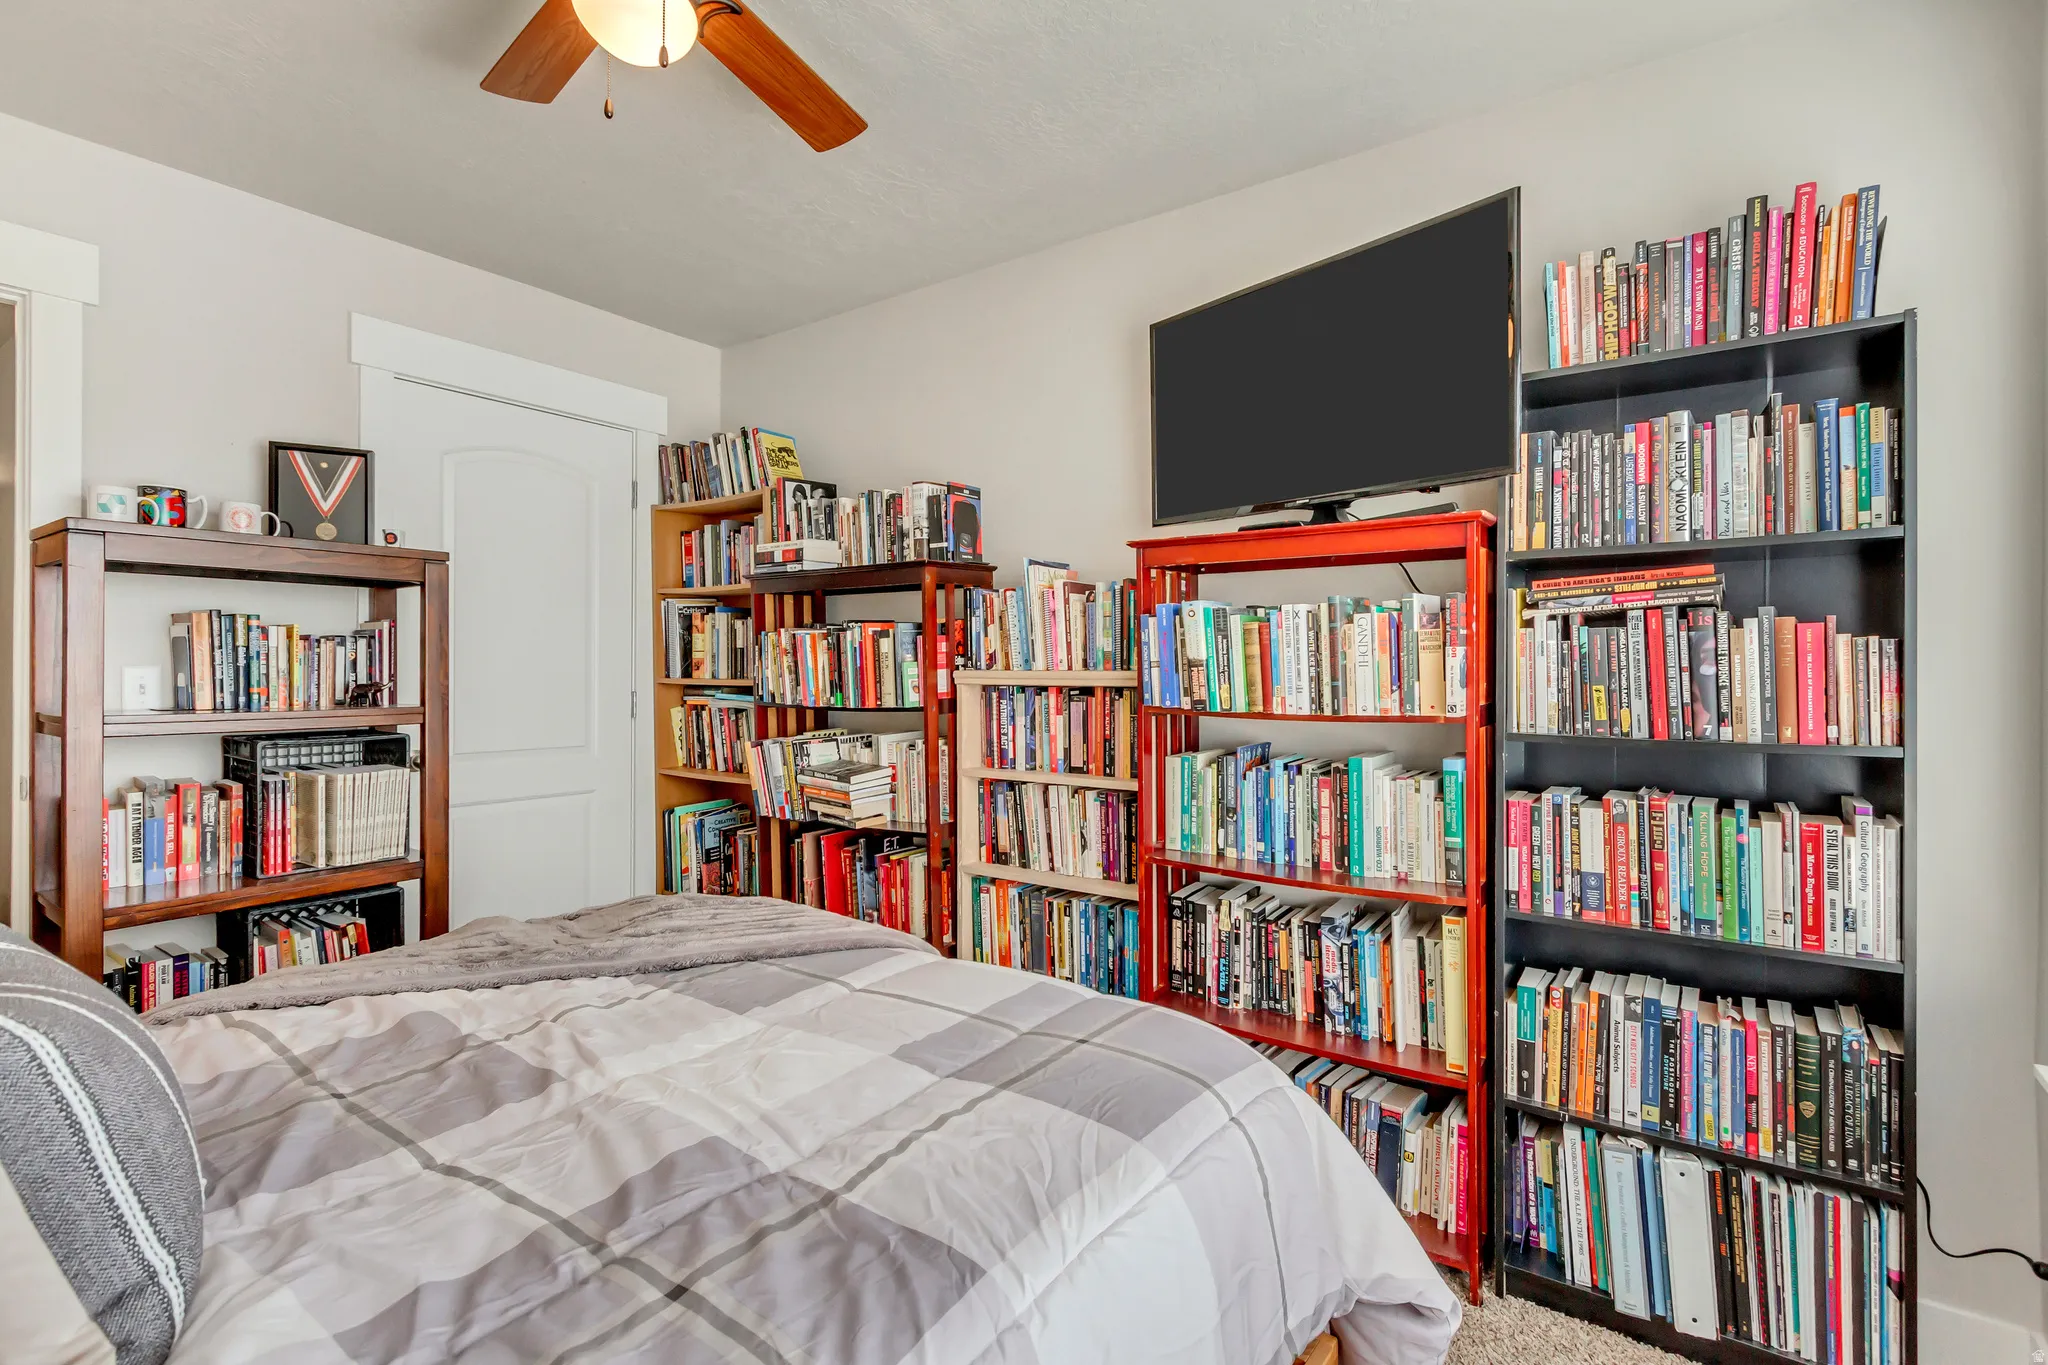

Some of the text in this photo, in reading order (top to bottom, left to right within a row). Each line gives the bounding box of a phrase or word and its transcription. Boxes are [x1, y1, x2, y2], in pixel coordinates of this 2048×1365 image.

[1865, 190, 1875, 228] REWEAVING
[1751, 232, 1761, 308] SOCIAL THEORY
[1695, 267, 1704, 330] HOW ANIMALS TALK
[1604, 300, 1618, 357] HIP HOP
[1594, 438, 1599, 447] WE
[1675, 441, 1686, 478] KLEIN
[1638, 443, 1646, 521] ACTIVIST'S HANDBOOK
[1719, 482, 1730, 537] Peace and War
[1553, 525, 1561, 548] NOAM
[1450, 598, 1458, 627] covert
[236, 617, 247, 667] Negotiating Globally
[1357, 617, 1369, 667] GANDHI
[1310, 667, 1315, 677] ME
[1665, 618, 1679, 707] ANIMAL OPPRESSION AND CAPITALISM
[1717, 613, 1729, 712] INADMISSIBLE EVIDENCE WILLIAMS
[1191, 667, 1199, 700] POWERFUL
[1000, 699, 1008, 734] PATRIOTS
[1750, 696, 1758, 725] ZIONISM
[131, 808, 142, 817] AT
[132, 822, 143, 846] TENDER
[167, 824, 175, 841] REBEL
[1827, 829, 1839, 852] STEAL
[1860, 820, 1869, 850] Cultural
[132, 847, 142, 859] AGE
[1572, 854, 1580, 870] NONE
[1616, 829, 1627, 901] GIROUX READER
[1827, 853, 1839, 869] THIS
[1639, 874, 1649, 900] planet
[1827, 871, 1839, 891] BOOK
[1859, 852, 1870, 893] Geography
[1829, 911, 1837, 932] HOFFMAN
[129, 984, 137, 1006] Animals
[174, 971, 182, 996] SOCIAL
[1427, 979, 1435, 987] be
[1428, 1001, 1436, 1024] change
[1747, 1055, 1756, 1072] KEY
[1845, 1069, 1853, 1149] THE LEGACY OF LUNA
[1706, 1120, 1714, 1137] USED
[1370, 1129, 1378, 1159] CONSPIRACY
[1527, 1160, 1535, 1192] Education
[1529, 1207, 1537, 1225] WASP
